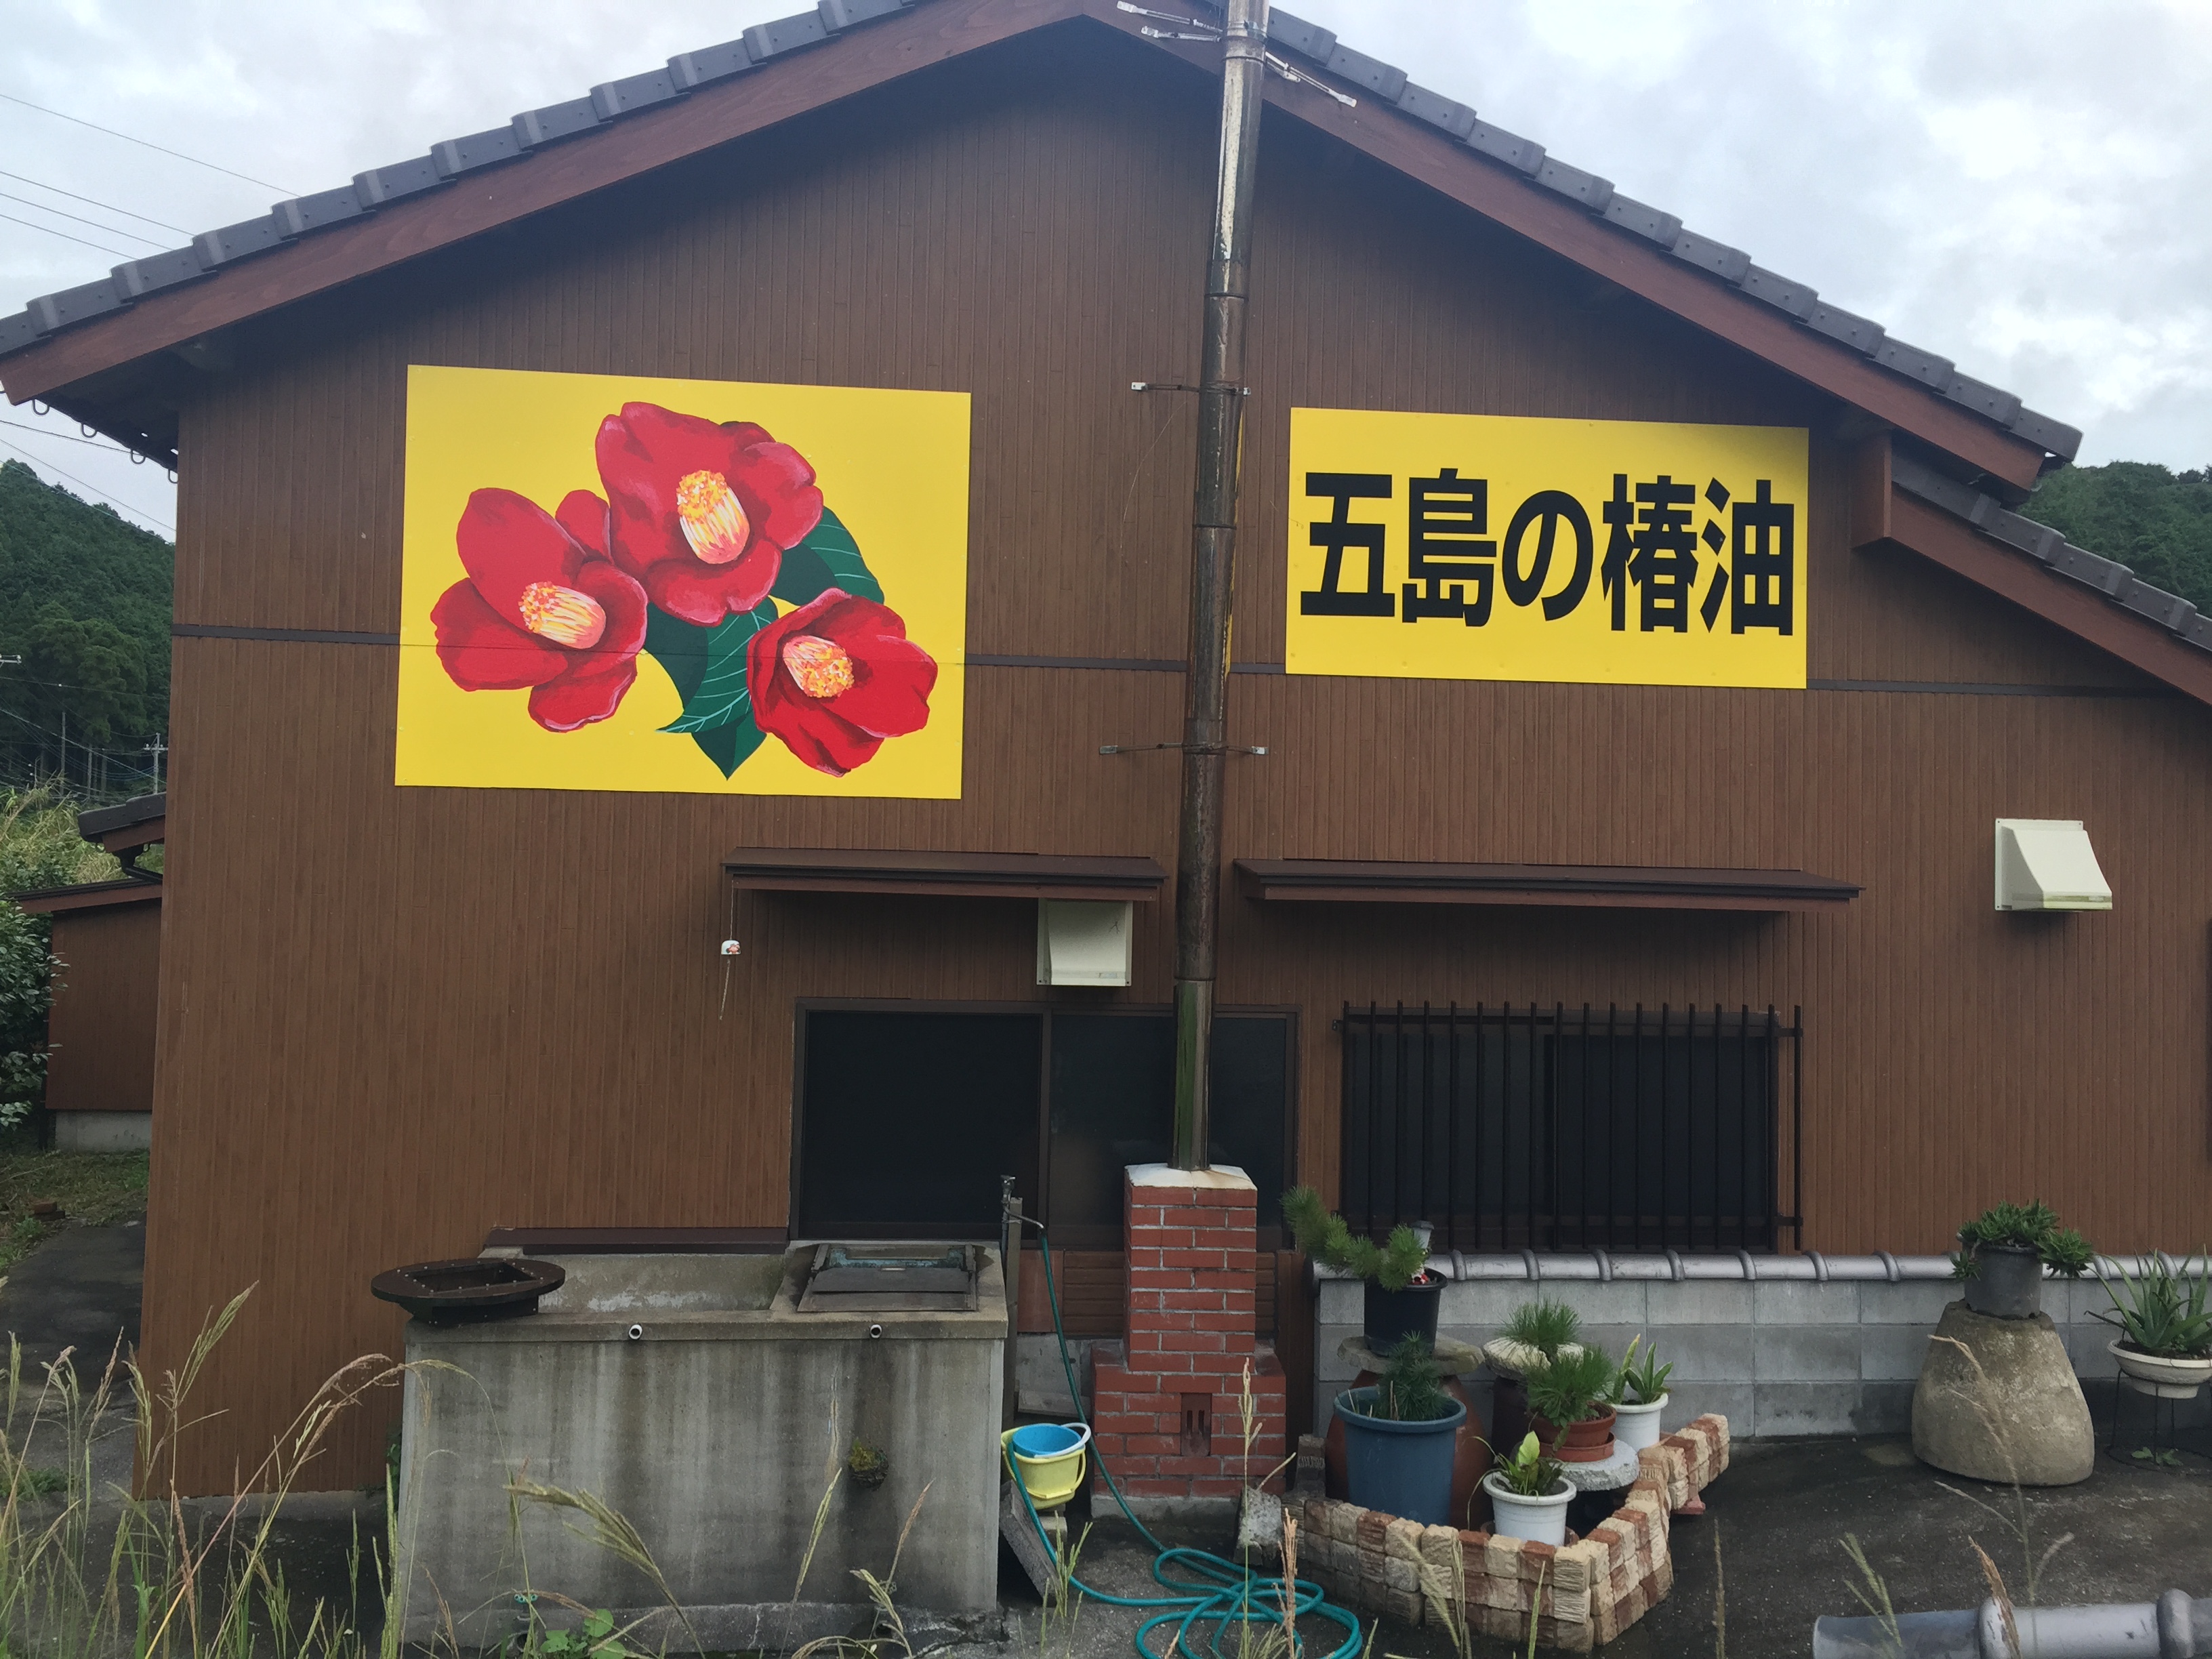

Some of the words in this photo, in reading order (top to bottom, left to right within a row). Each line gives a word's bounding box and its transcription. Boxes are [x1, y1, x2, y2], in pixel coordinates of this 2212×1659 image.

[1300, 468, 1794, 636] 五島の椿油
